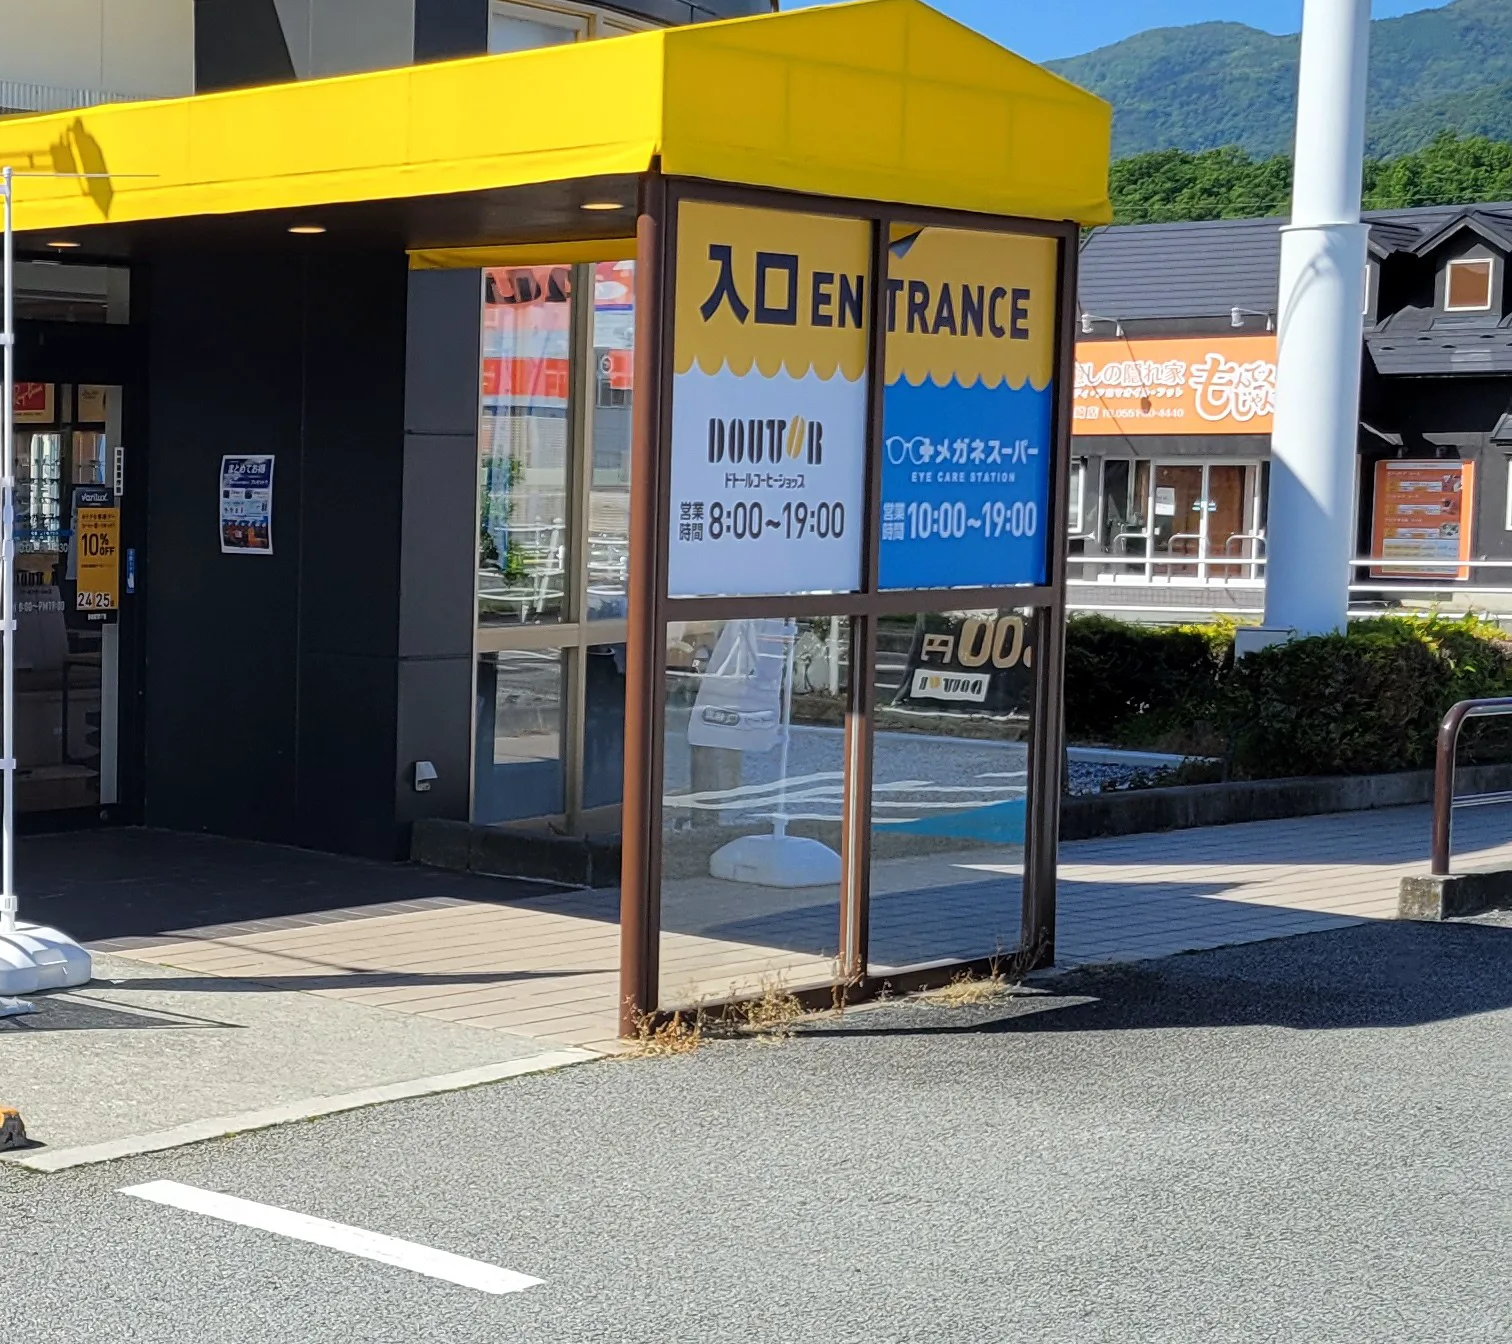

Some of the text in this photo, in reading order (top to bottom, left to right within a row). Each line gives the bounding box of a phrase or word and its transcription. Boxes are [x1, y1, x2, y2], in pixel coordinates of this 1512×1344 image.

[699, 243, 1031, 340] 入口 ENTRANCE
[707, 415, 824, 465] DOUTOR
[935, 437, 1039, 465] メガネスーパー
[911, 471, 1016, 483] EYE CARE STATION
[680, 501, 705, 521] 営業
[679, 522, 704, 542] 時間
[99, 546, 115, 556] OFF
